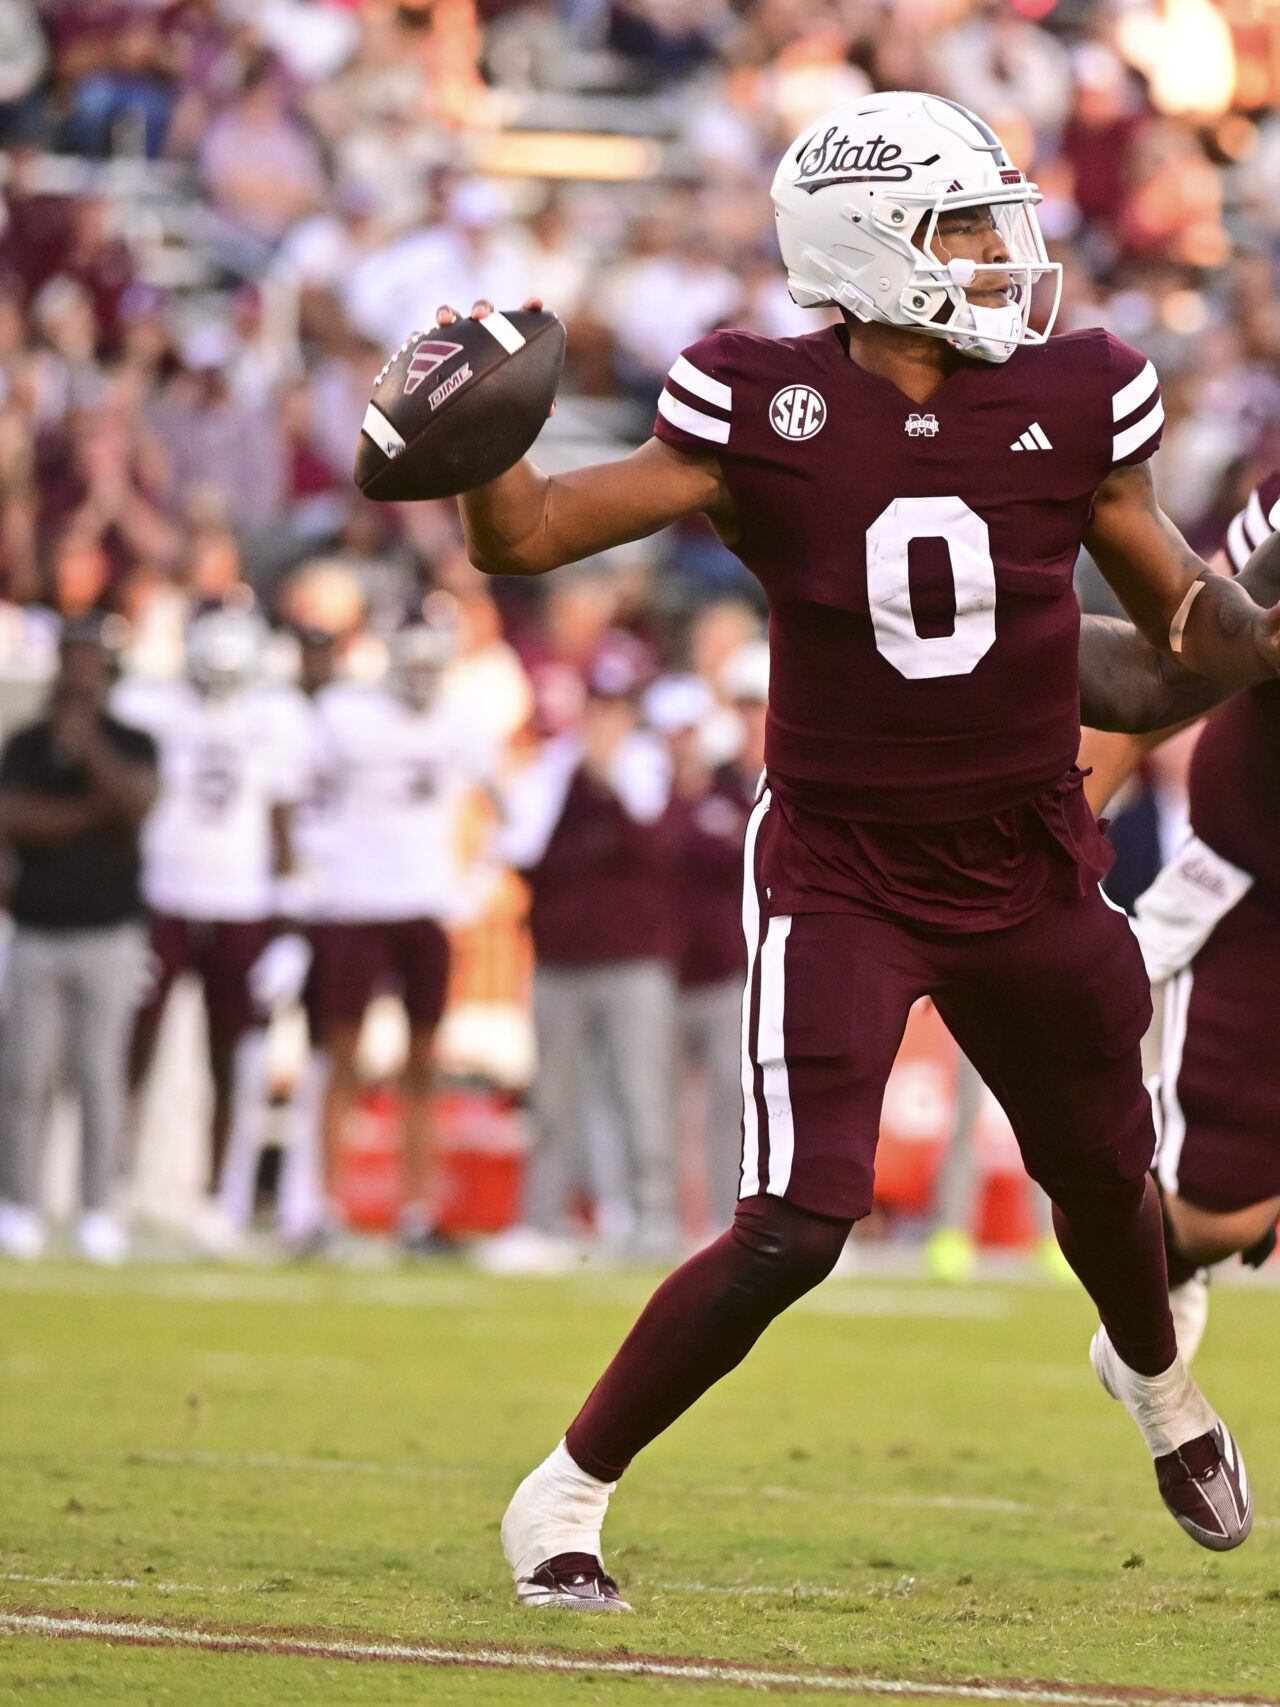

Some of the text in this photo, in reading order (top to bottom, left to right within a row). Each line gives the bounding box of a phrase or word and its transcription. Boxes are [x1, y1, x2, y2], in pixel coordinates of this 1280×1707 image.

[795, 126, 912, 192] State
[428, 362, 473, 411] DIME
[773, 387, 822, 437] SEC
[866, 496, 996, 680] 0
